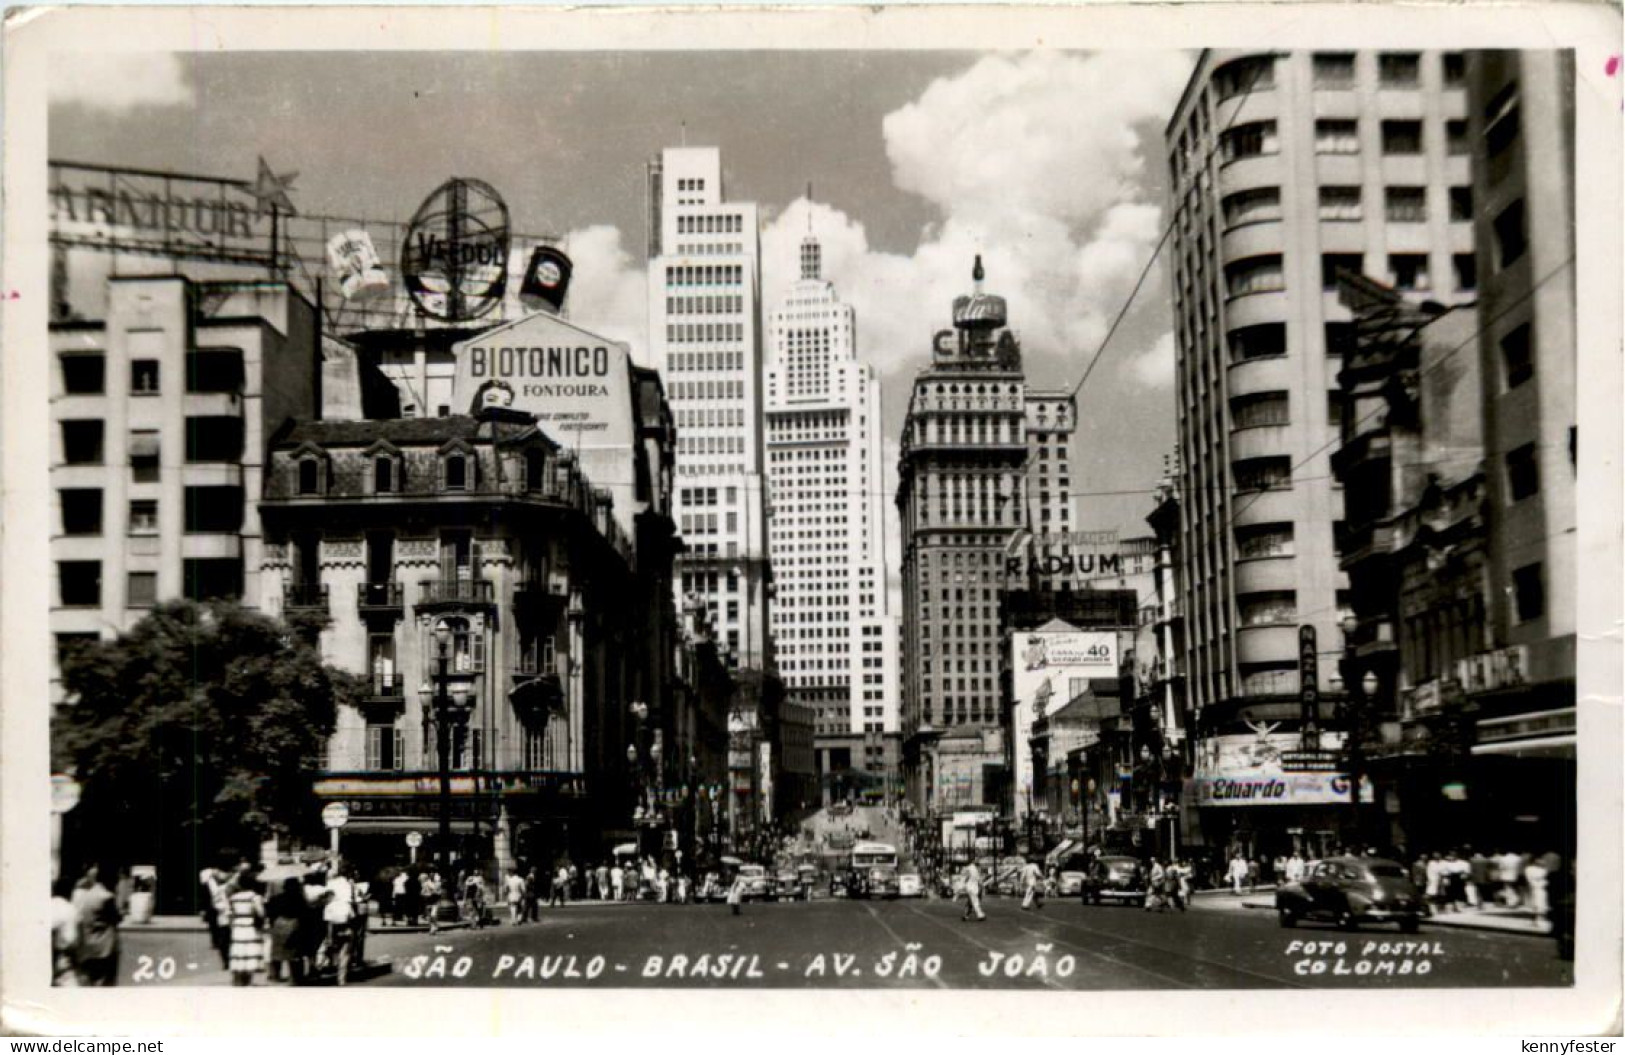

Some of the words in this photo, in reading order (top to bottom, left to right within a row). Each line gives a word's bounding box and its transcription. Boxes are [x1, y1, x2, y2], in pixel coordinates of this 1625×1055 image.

[49, 184, 252, 238] ARMOUR
[471, 346, 609, 378] BIOTONICO
[523, 384, 609, 397] FONTOURA
[1005, 553, 1119, 576] RADIUM
[1088, 644, 1110, 657] 40
[1212, 778, 1286, 799] Eduardo
